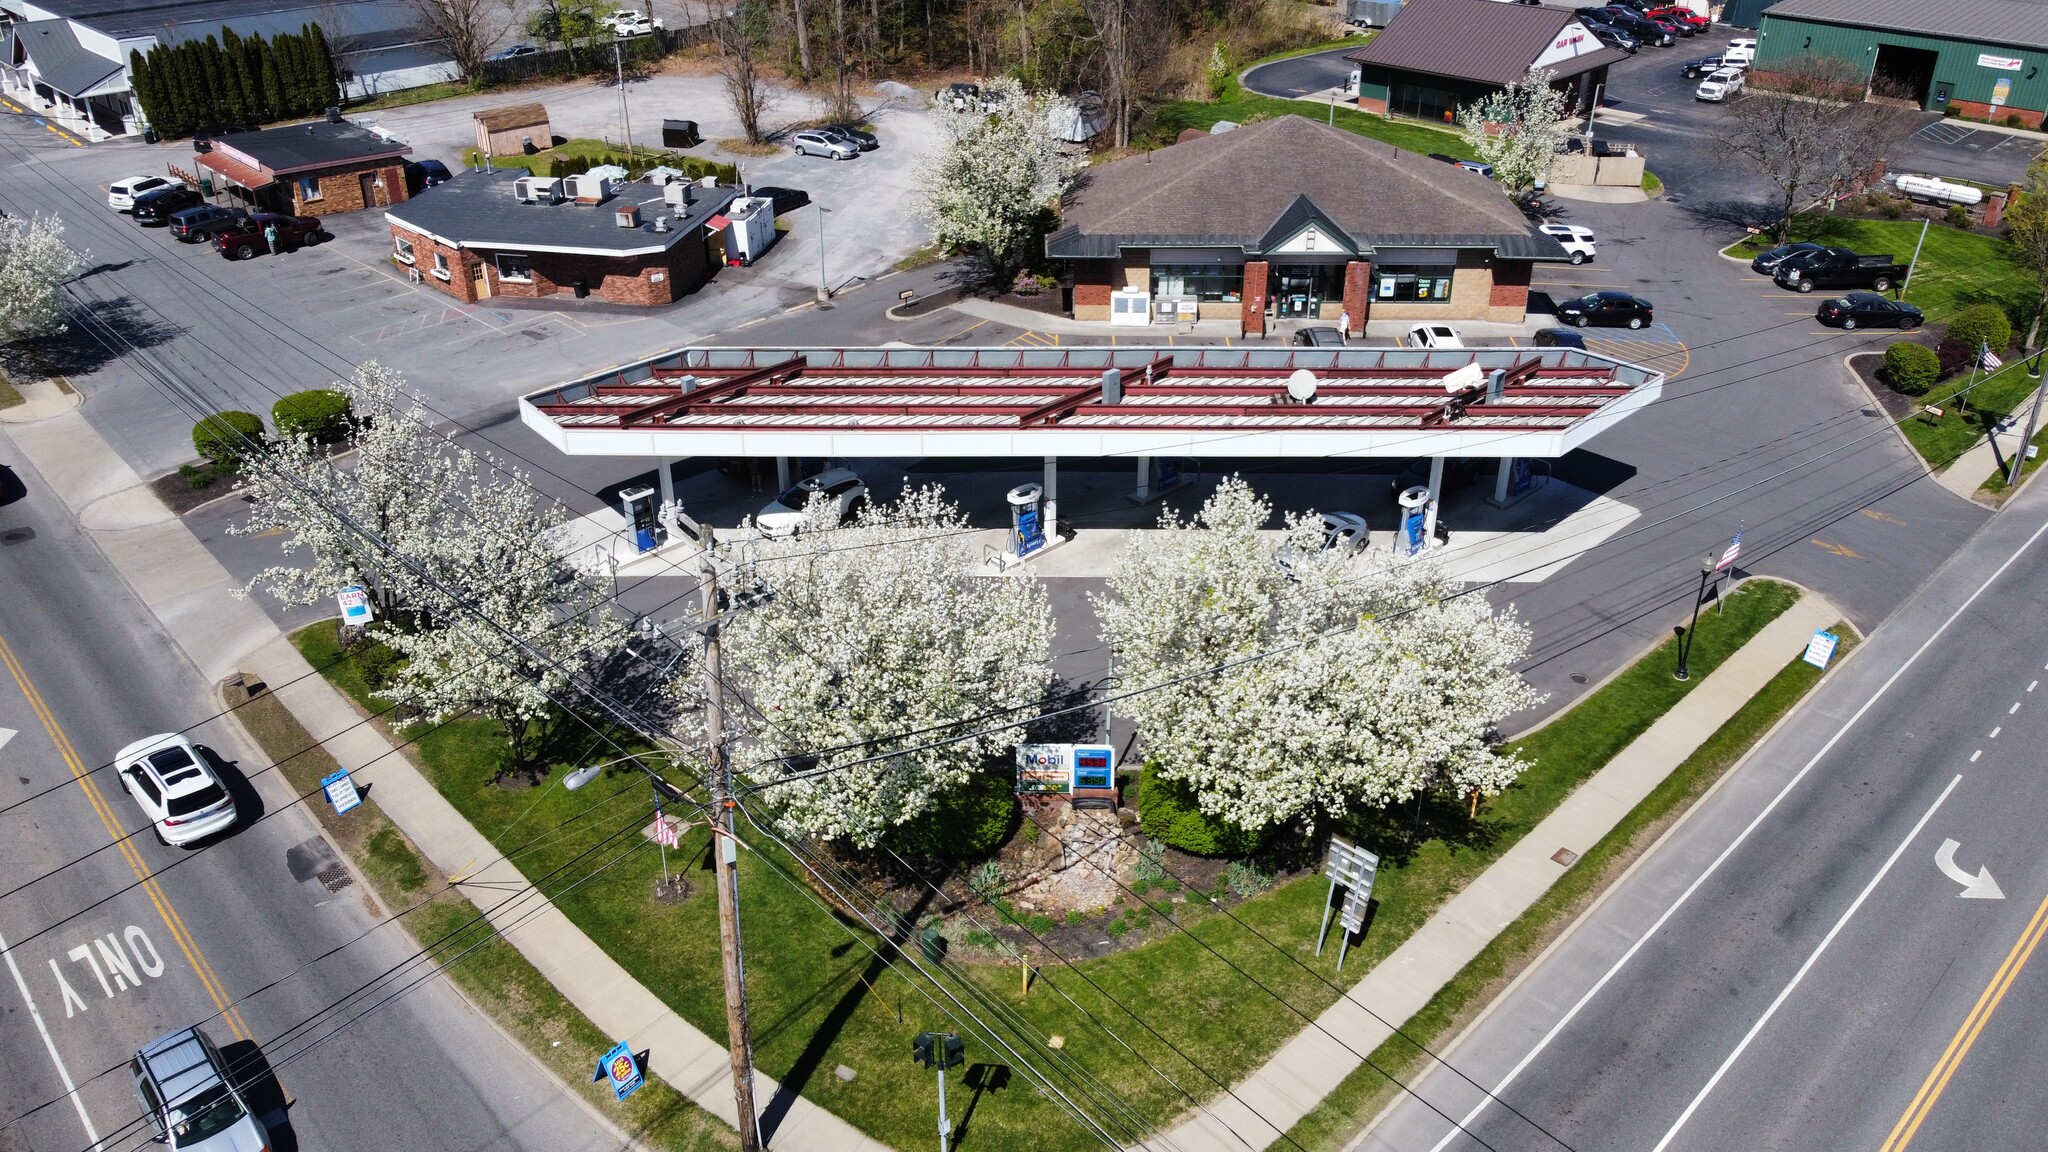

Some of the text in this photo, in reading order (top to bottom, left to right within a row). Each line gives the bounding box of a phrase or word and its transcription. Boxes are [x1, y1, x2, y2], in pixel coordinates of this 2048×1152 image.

[1556, 34, 1584, 49] CAR WASH
[340, 591, 364, 600] EARN
[1026, 754, 1064, 766] Mobil
[49, 925, 164, 1019] ONLY
